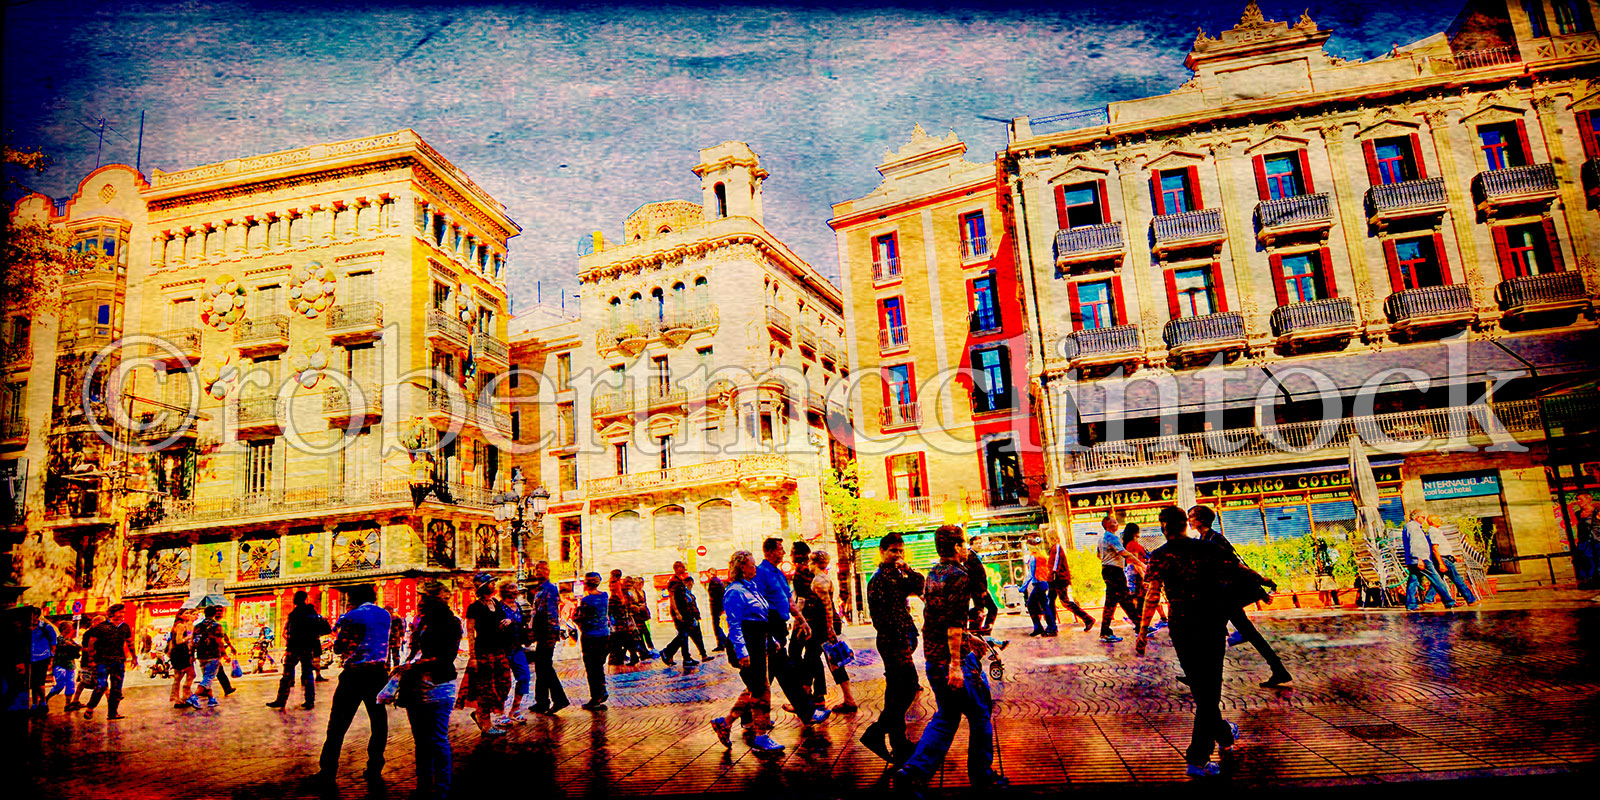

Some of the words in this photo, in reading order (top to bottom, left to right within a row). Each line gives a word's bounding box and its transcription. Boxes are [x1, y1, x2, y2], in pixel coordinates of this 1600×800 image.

[1095, 490, 1150, 507] ANTIGA
[1161, 486, 1203, 501] CAA
[1423, 488, 1437, 497] cool
[1438, 487, 1453, 495] local
[1454, 485, 1473, 494] hotel
